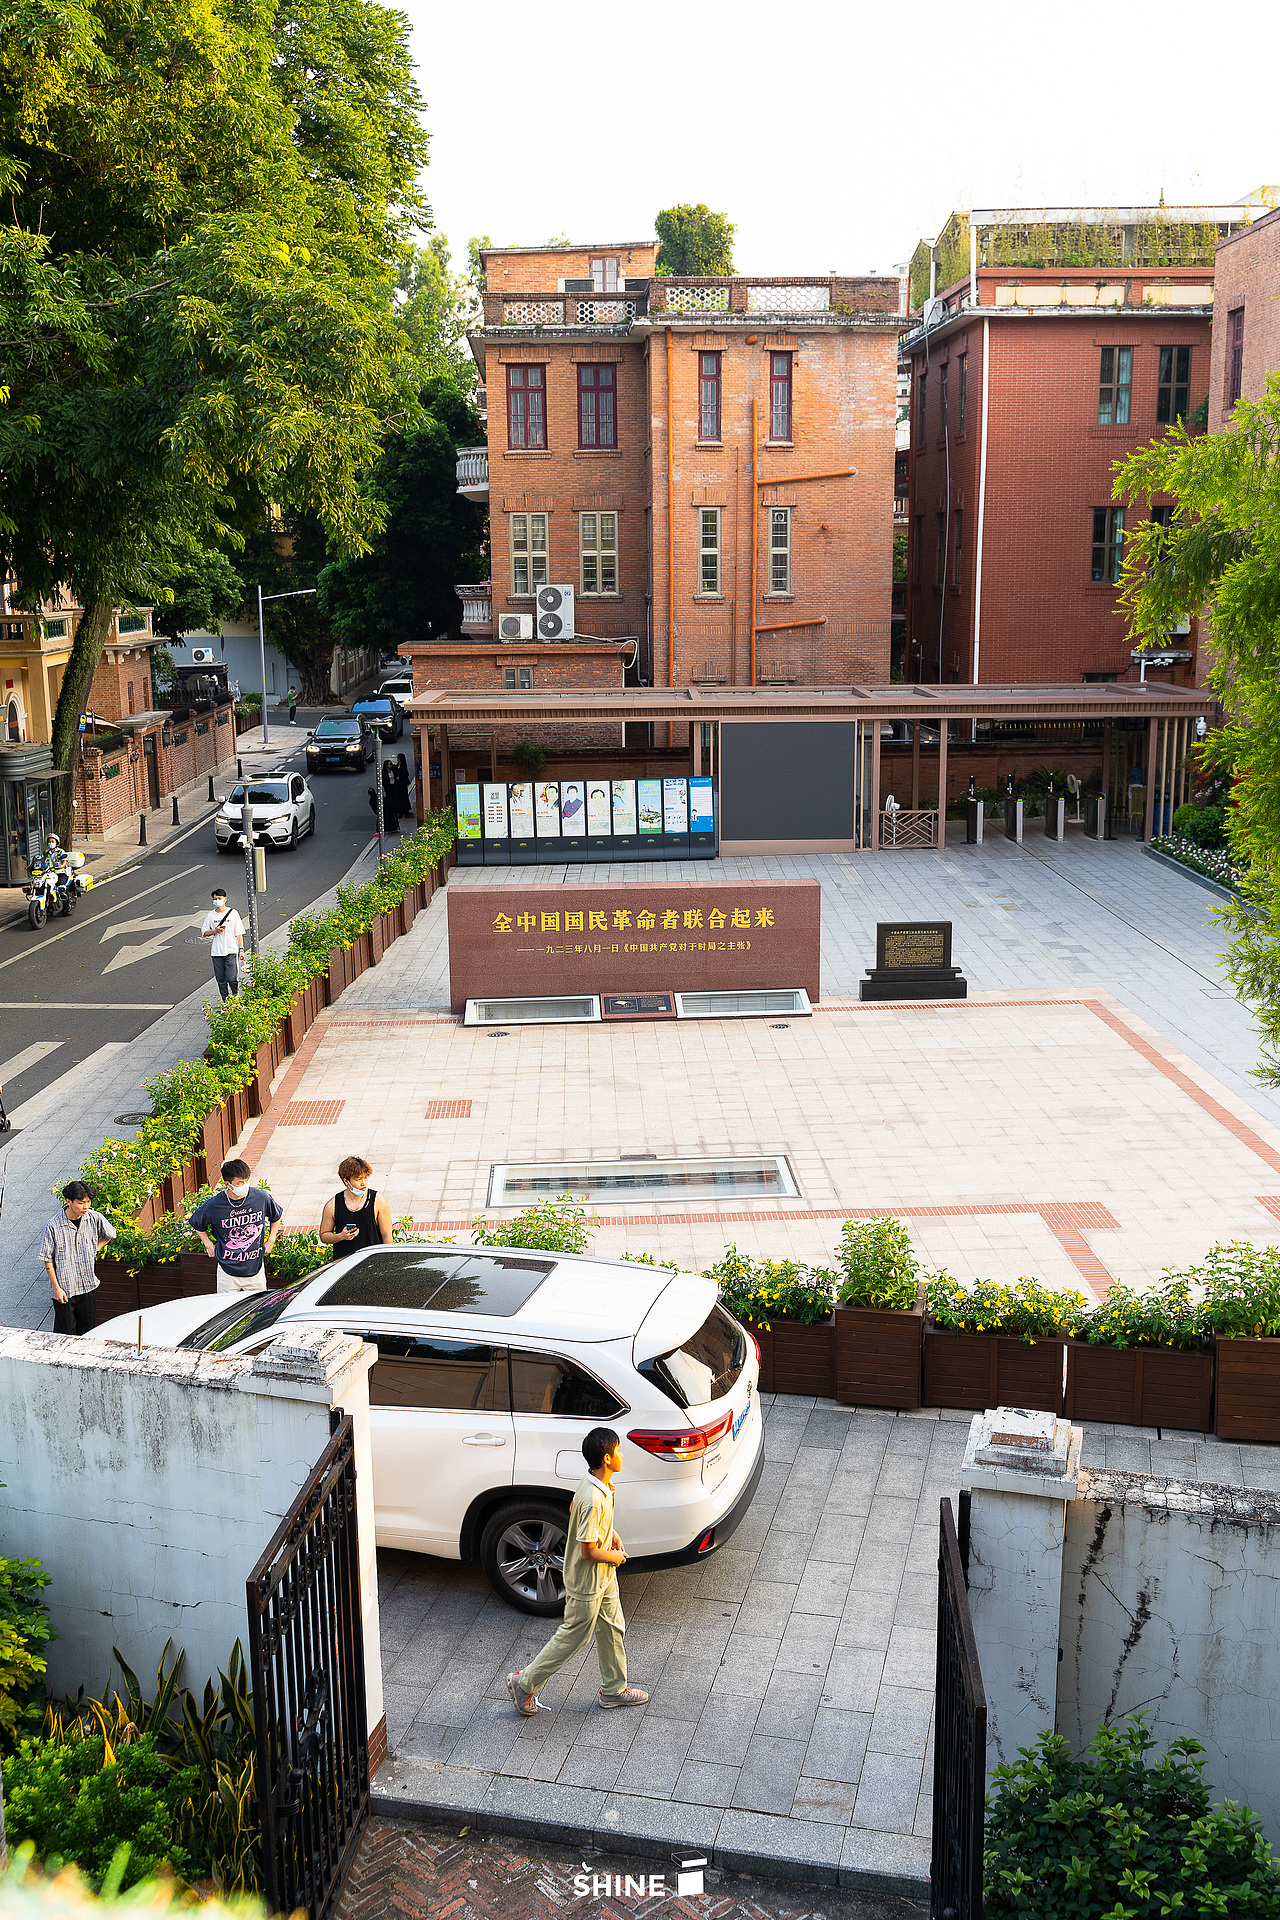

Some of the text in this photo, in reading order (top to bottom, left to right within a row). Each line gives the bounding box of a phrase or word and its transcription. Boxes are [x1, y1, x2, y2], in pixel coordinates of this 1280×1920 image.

[491, 907, 775, 933] 全中国国民革命者联合起来
[221, 1211, 262, 1228] KINDER
[222, 1247, 262, 1261] PLANET
